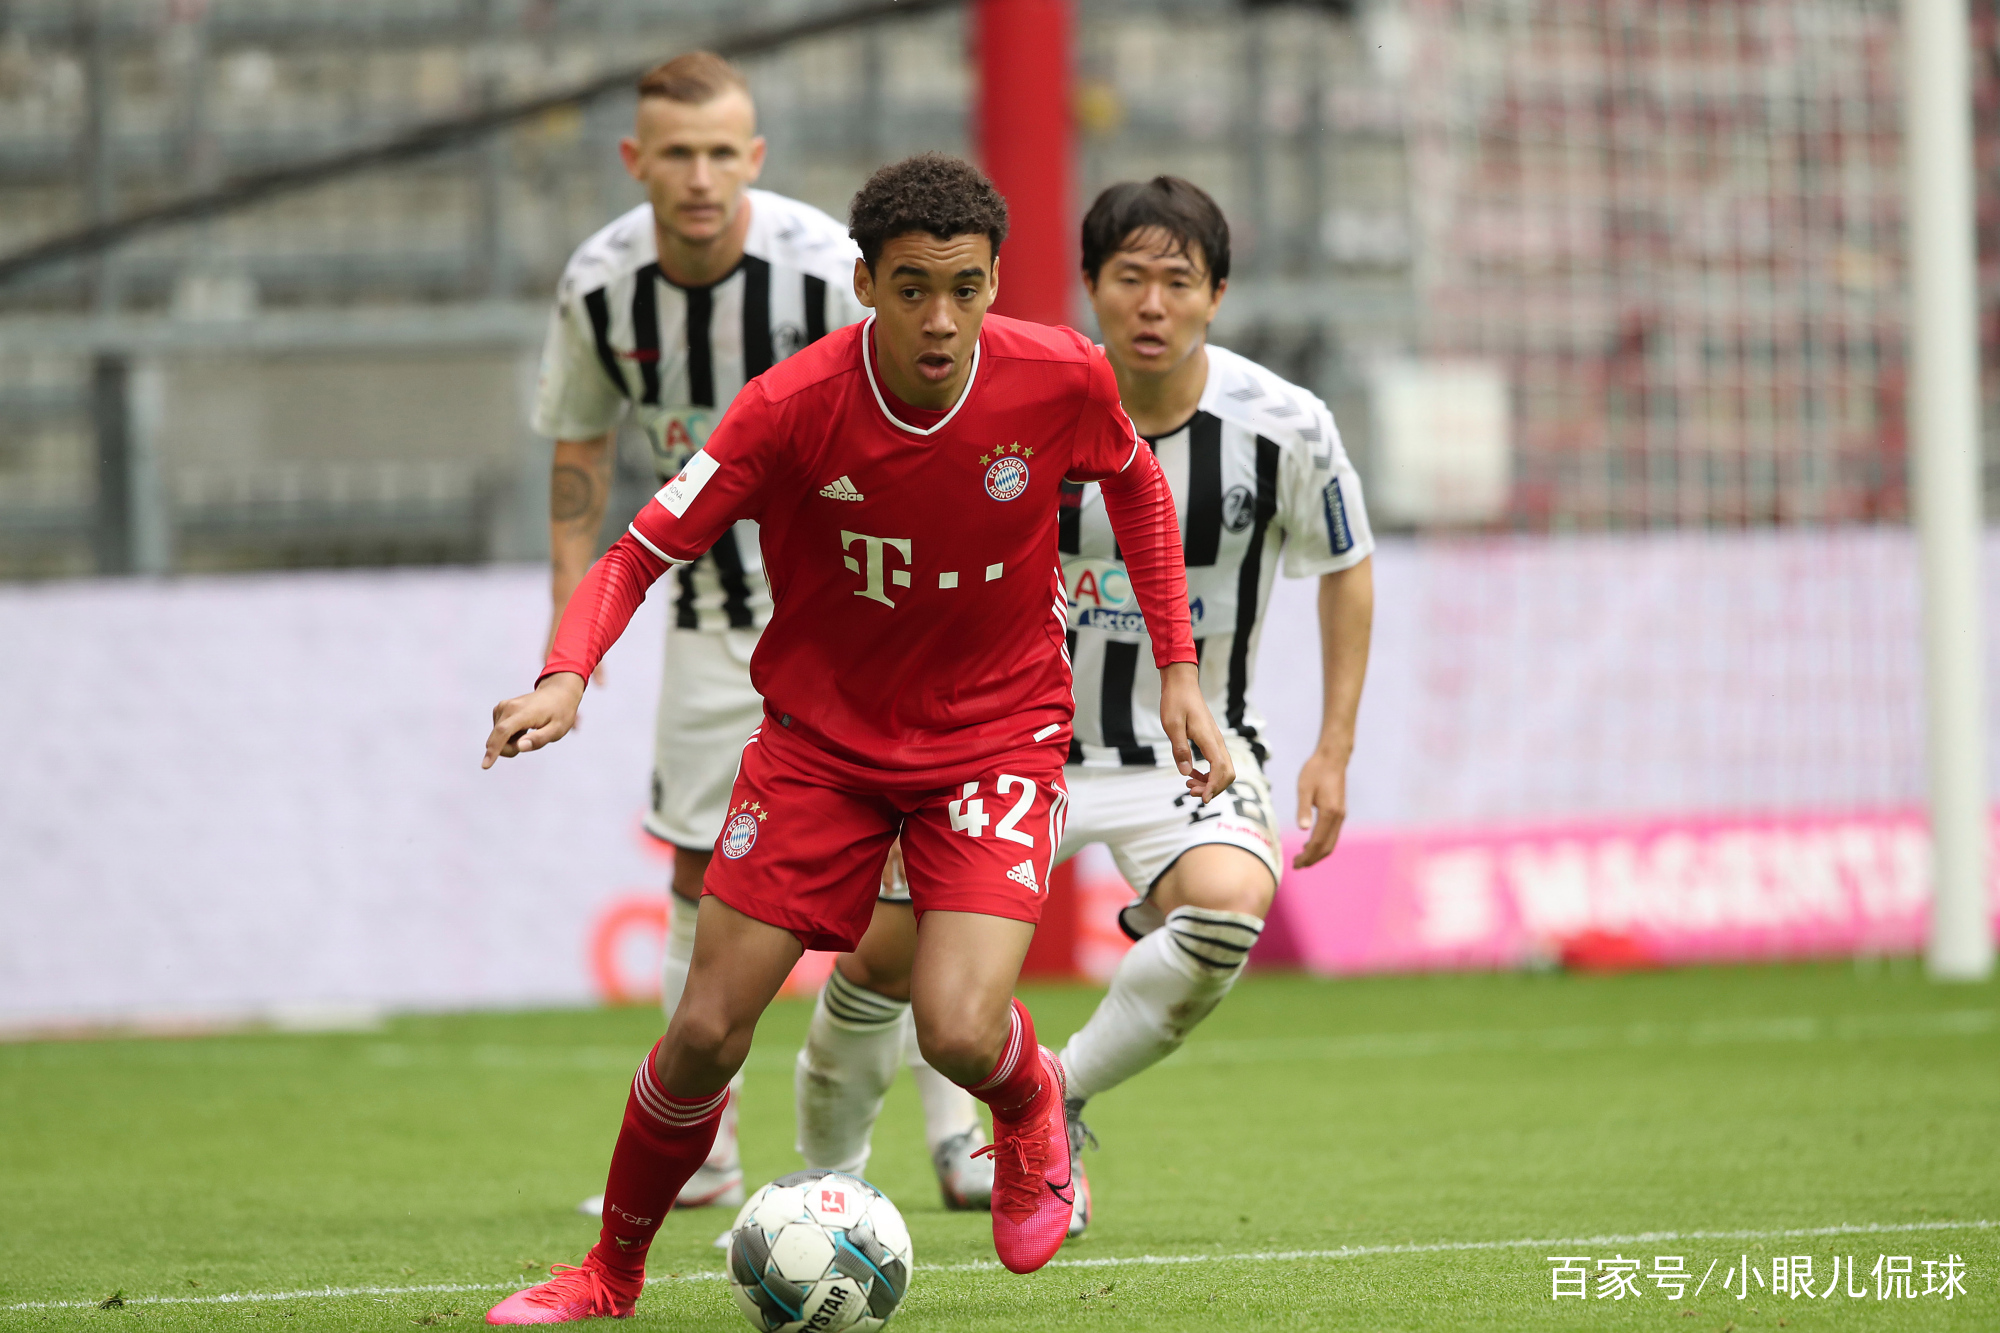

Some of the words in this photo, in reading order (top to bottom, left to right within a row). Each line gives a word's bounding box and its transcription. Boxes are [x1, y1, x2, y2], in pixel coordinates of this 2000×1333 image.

[989, 469, 998, 478] FC
[998, 460, 1025, 473] BAYERN
[819, 489, 865, 501] adidas
[1067, 568, 1128, 607] AC
[948, 773, 1037, 849] 42
[738, 817, 755, 835] BAYERN
[1006, 869, 1039, 894] adidas
[611, 1203, 652, 1226] FCB
